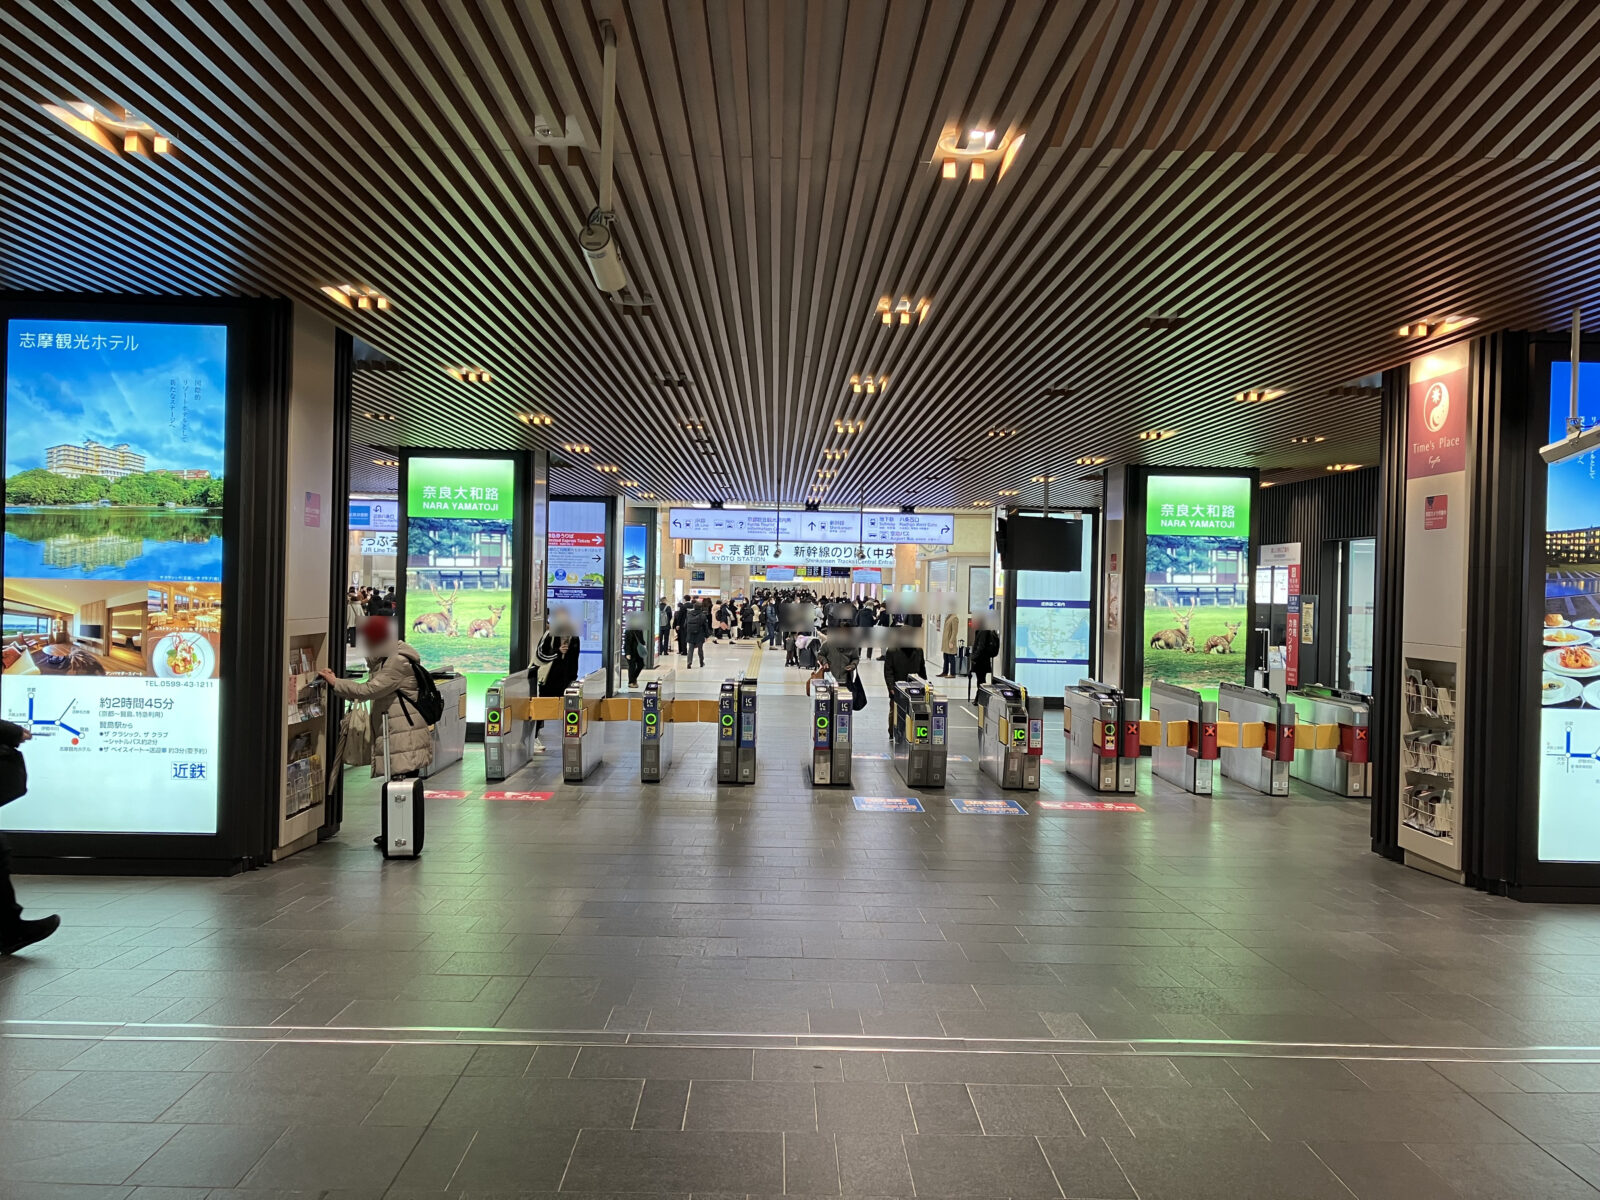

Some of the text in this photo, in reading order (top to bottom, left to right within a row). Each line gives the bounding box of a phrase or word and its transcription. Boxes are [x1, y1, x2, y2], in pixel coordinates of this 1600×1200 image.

[19, 332, 139, 351] 志摩観光ホテル
[1413, 436, 1460, 454] Time's Place
[422, 486, 499, 501] 奈良大和路
[422, 501, 499, 511] NARA YAMATOJI
[1160, 503, 1236, 518] 奈良大和路
[1160, 519, 1235, 529] NARA YAMATOJI
[708, 543, 724, 552] JR
[729, 544, 769, 556] 京都駅
[145, 680, 214, 688] TEL.0599-43-1211
[99, 697, 175, 710] 約2時間45分
[99, 721, 134, 729] 賢島駅から
[916, 726, 928, 737] IC
[1014, 729, 1025, 740] IC
[172, 762, 206, 779] 近鉄
